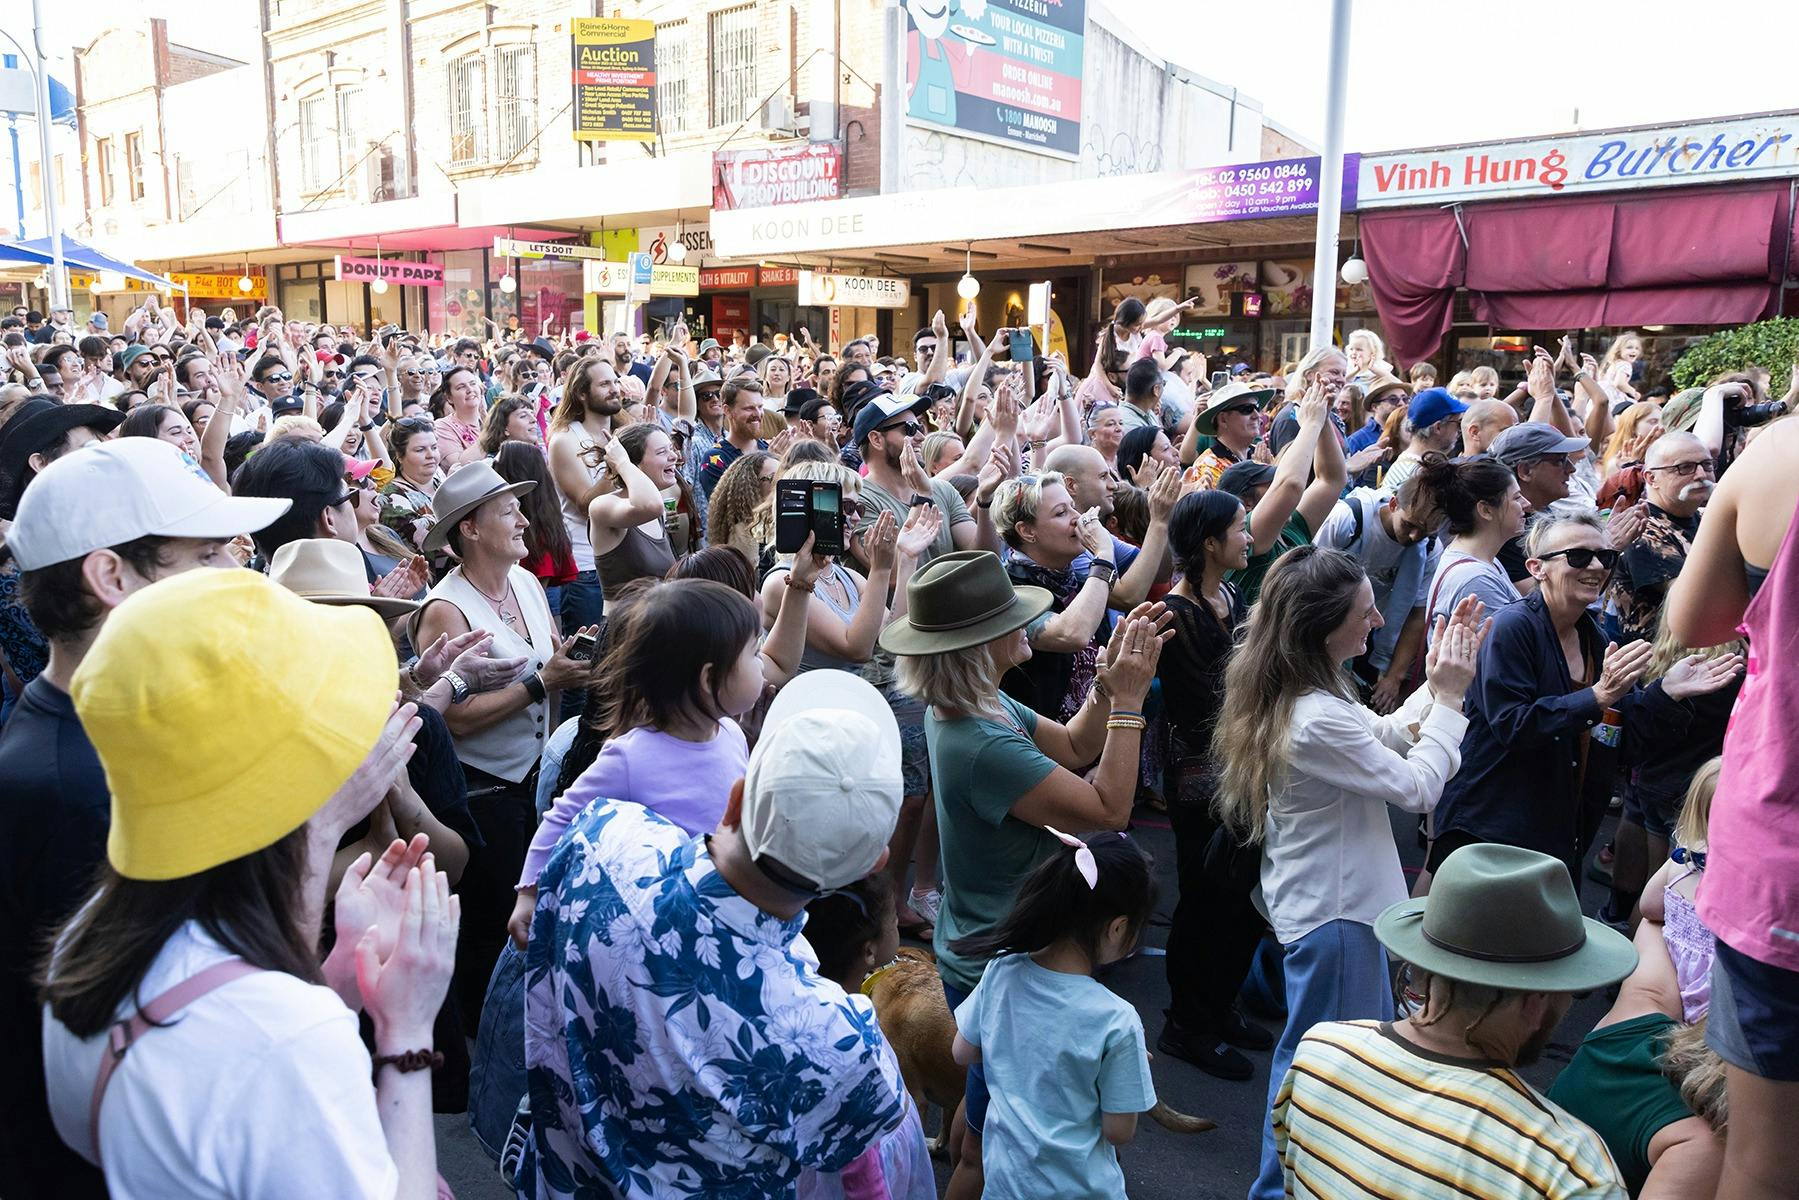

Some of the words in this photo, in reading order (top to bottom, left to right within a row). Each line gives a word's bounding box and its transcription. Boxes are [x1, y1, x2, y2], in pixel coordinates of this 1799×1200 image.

[580, 29, 626, 38] Commercial
[990, 12, 1010, 32] YOUR
[1012, 18, 1034, 40] LOCAL
[1035, 26, 1065, 49] PIZZERIA
[581, 47, 639, 63] Auction
[1003, 36, 1022, 55] WITH
[1023, 43, 1029, 57] A
[1030, 45, 1054, 64] TWIST!
[1002, 64, 1026, 83] ORDER
[1028, 71, 1053, 90] ONLINE
[992, 82, 1061, 112] manoosh.com.au
[1005, 109, 1022, 125] 1800
[1023, 113, 1057, 134] MANOOSH
[749, 157, 835, 183] DISCOUNT
[1374, 161, 1450, 192] Vinh
[1464, 148, 1568, 190] Hung
[1585, 133, 1792, 179] Butcher
[1219, 171, 1235, 184] 02
[1239, 167, 1270, 181] 9560
[1274, 164, 1306, 179] 0846
[748, 178, 837, 204] BODYBUILDING
[1225, 184, 1256, 197] 0450
[1259, 181, 1283, 194] 542
[1287, 178, 1313, 192] 899
[1245, 198, 1253, 206] 10
[1275, 196, 1280, 204] 9
[1281, 195, 1296, 204] pm
[752, 219, 809, 241] KOON
[821, 213, 864, 235] DEE
[552, 246, 564, 254] DO
[342, 262, 399, 277] DONUT
[403, 268, 442, 281] PAPI
[652, 270, 696, 283] SUPPLEMENTS
[714, 273, 719, 285] &
[720, 271, 749, 284] VITALITY
[761, 269, 784, 283] SHAKE
[217, 277, 234, 288] HOT
[845, 278, 872, 290] KOON
[878, 279, 896, 292] DEE
